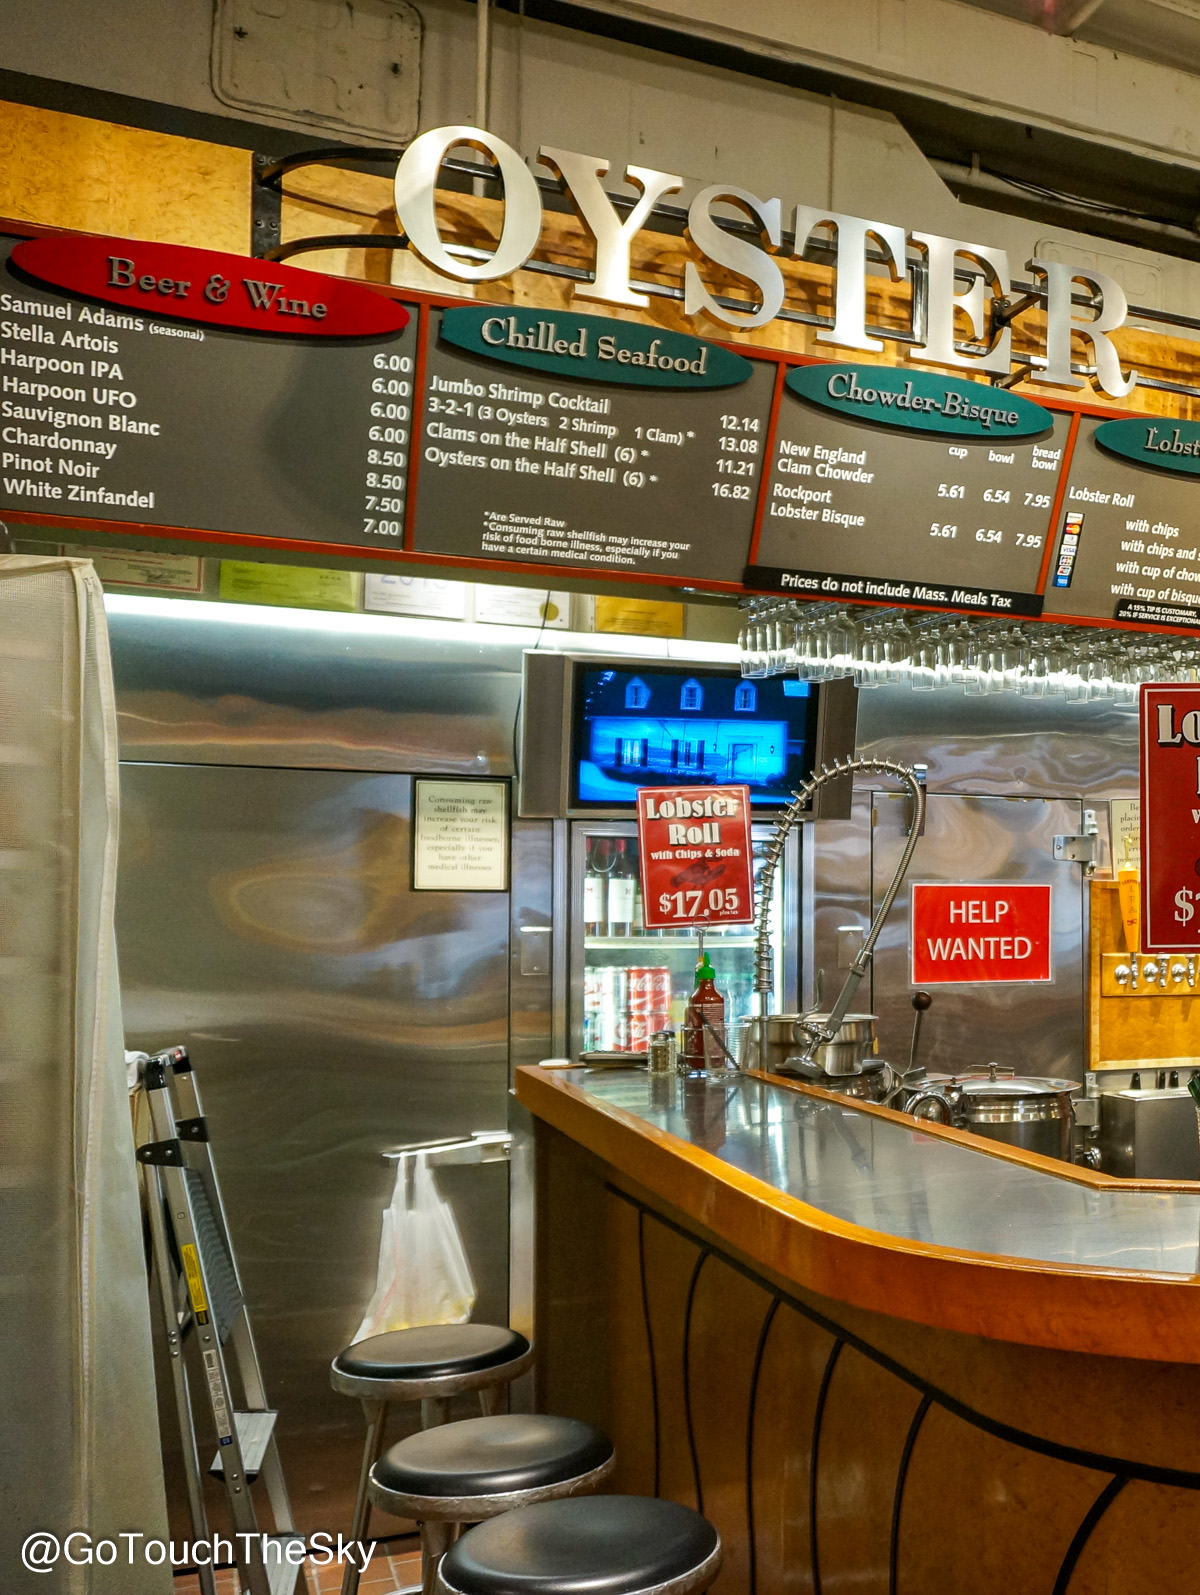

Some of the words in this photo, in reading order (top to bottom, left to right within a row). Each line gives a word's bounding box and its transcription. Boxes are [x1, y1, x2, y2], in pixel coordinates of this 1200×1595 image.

[394, 125, 1139, 399] OYSTER
[108, 255, 191, 298] Beer
[205, 274, 231, 302] &
[243, 278, 327, 319] Wine
[0, 294, 72, 321] Samuel
[78, 306, 144, 332] Adams
[149, 322, 205, 341] (seasonal)
[0, 321, 55, 345] Stella
[61, 330, 119, 354] Artois
[481, 316, 586, 358] Chilled
[598, 336, 707, 375] Seafood
[0, 348, 85, 376] Harpoon
[91, 361, 124, 380] IPA
[373, 353, 411, 372] 6.00
[2, 376, 87, 403] Harpoon
[93, 388, 136, 408] UFO
[371, 377, 410, 397] 6.00
[429, 376, 484, 397] Jumbo
[488, 383, 544, 406] Shrimp
[548, 393, 610, 414] Cocktail
[370, 402, 409, 421] 6.00
[827, 372, 1019, 428] Chowder-Bisque
[1, 402, 102, 429] Sauvignon
[108, 414, 160, 436] Blanc
[429, 397, 473, 417] 3-2-1
[478, 405, 494, 420] (3
[496, 407, 548, 427] Oysters
[559, 417, 569, 430] 2
[572, 419, 618, 438] Shrimp
[635, 427, 643, 440] 1
[646, 428, 683, 446] Clam)
[720, 415, 760, 432] 12.14
[2, 427, 117, 458] Chardonnay
[368, 425, 407, 444] 6.00
[718, 437, 758, 453] 13.08
[367, 449, 406, 468] 8.50
[780, 440, 810, 456] New
[814, 445, 866, 465] England
[948, 446, 968, 460] cup
[988, 450, 1014, 464] bowl
[1032, 446, 1061, 460] bread
[1032, 458, 1057, 470] bowl
[2, 453, 52, 473] Pinot
[58, 459, 99, 479] Noir
[425, 447, 486, 468] Oysters
[490, 456, 510, 471] on
[515, 458, 539, 474] the
[543, 461, 576, 478] Half
[579, 466, 615, 484] Shell
[623, 471, 645, 487] (6)
[778, 458, 811, 475] Clam
[815, 463, 874, 484] Chowder
[3, 478, 62, 499] White
[67, 485, 155, 509] Zinfandel
[365, 473, 404, 491] 8.50
[711, 483, 751, 500] 16.82
[773, 483, 832, 504] Rockport
[365, 496, 402, 514] 7.50
[938, 484, 966, 499] 5.61
[983, 489, 1010, 504] 6.54
[1024, 493, 1050, 508] 7.95
[1069, 486, 1110, 504] Lobster
[1112, 492, 1135, 508] Roll
[509, 514, 541, 526] Served
[544, 518, 566, 528] Raw
[770, 502, 819, 522] Lobster
[822, 508, 865, 528] Bisque
[363, 519, 400, 536] 7.00
[1125, 519, 1149, 533] with
[1152, 521, 1180, 539] chips
[1121, 539, 1145, 554] with
[1147, 542, 1175, 559] chips
[1177, 546, 1196, 561] and
[1116, 560, 1140, 575] with
[1142, 565, 1161, 580] cup
[1163, 565, 1175, 579] of
[780, 574, 818, 590] Prices
[822, 577, 838, 591] do
[842, 580, 864, 594] not
[866, 580, 910, 598] include
[913, 586, 948, 602] Mass.
[952, 590, 988, 606] Meals
[990, 594, 1012, 608] Tax
[646, 796, 738, 819] Lobster
[668, 823, 721, 846] Roll
[651, 850, 672, 860] with
[675, 849, 702, 860] Chips
[705, 850, 714, 858] &
[716, 848, 740, 858] Soda
[659, 888, 738, 918] $17.05
[950, 901, 1008, 923] HELP
[927, 937, 1032, 960] WANTED
